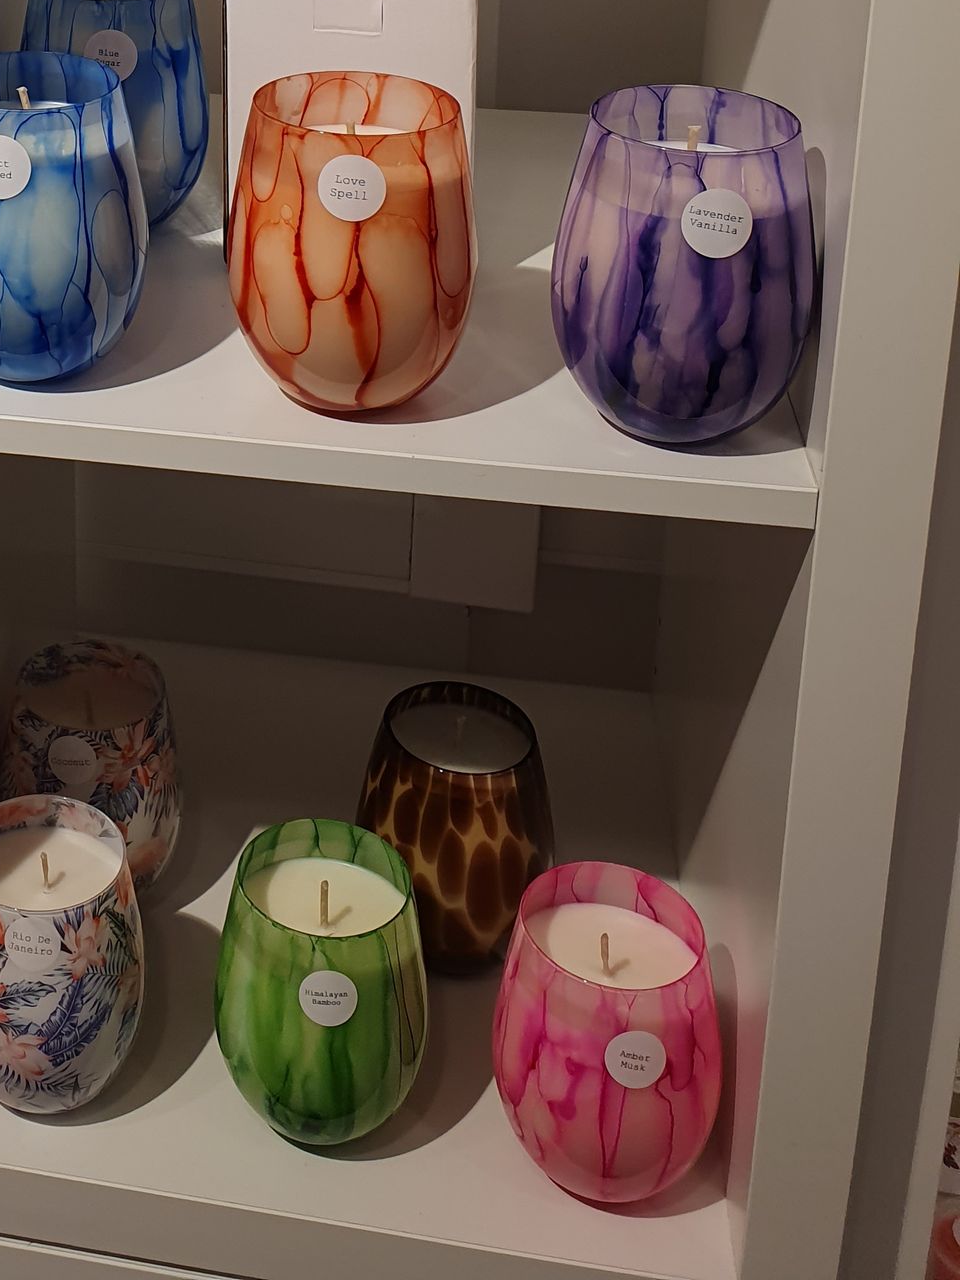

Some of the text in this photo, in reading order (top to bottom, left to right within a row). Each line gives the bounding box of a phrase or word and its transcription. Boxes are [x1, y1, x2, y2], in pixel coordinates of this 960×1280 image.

[98, 49, 120, 57] Blue
[335, 174, 366, 187] Love
[329, 187, 368, 201] Spell
[689, 205, 745, 224] Lavender
[689, 217, 738, 235] Vanilla
[12, 931, 51, 945] Rio De
[8, 941, 53, 956] Janeiro
[304, 989, 349, 999] Himalayan
[312, 998, 342, 1006] Bamboo
[620, 1050, 651, 1062] Amber
[620, 1060, 646, 1072] Musk
